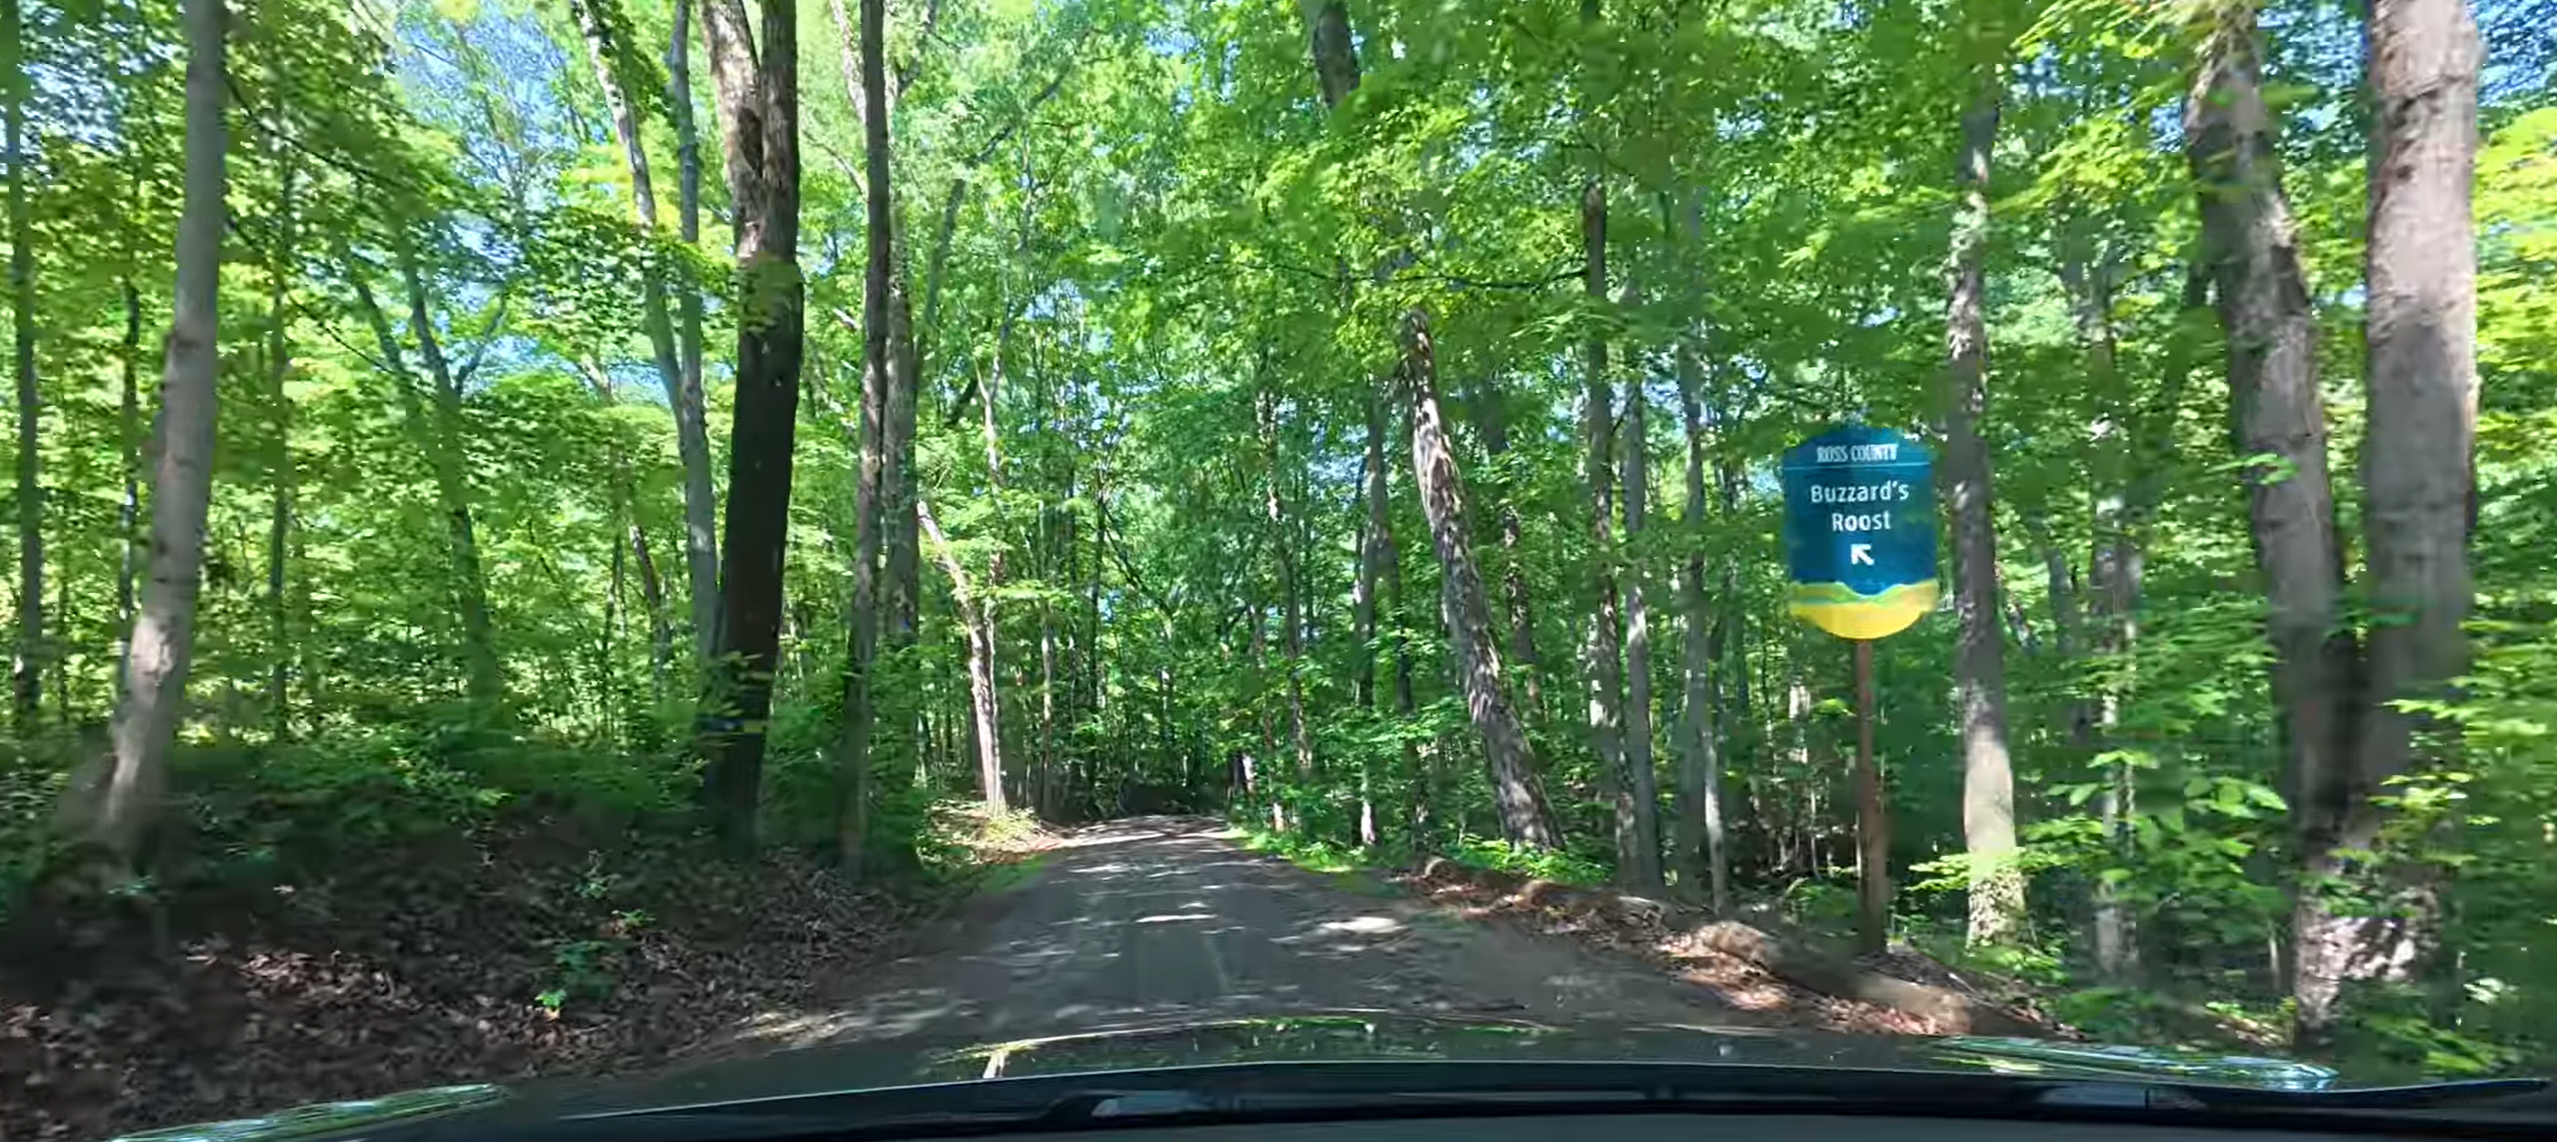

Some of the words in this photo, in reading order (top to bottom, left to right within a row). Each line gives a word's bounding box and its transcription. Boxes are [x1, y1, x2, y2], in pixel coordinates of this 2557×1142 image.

[1816, 445, 1848, 463] ROSS
[1850, 443, 1899, 462] COUNTY
[1810, 480, 1910, 503] Buzzard's
[1832, 510, 1891, 532] Roost
